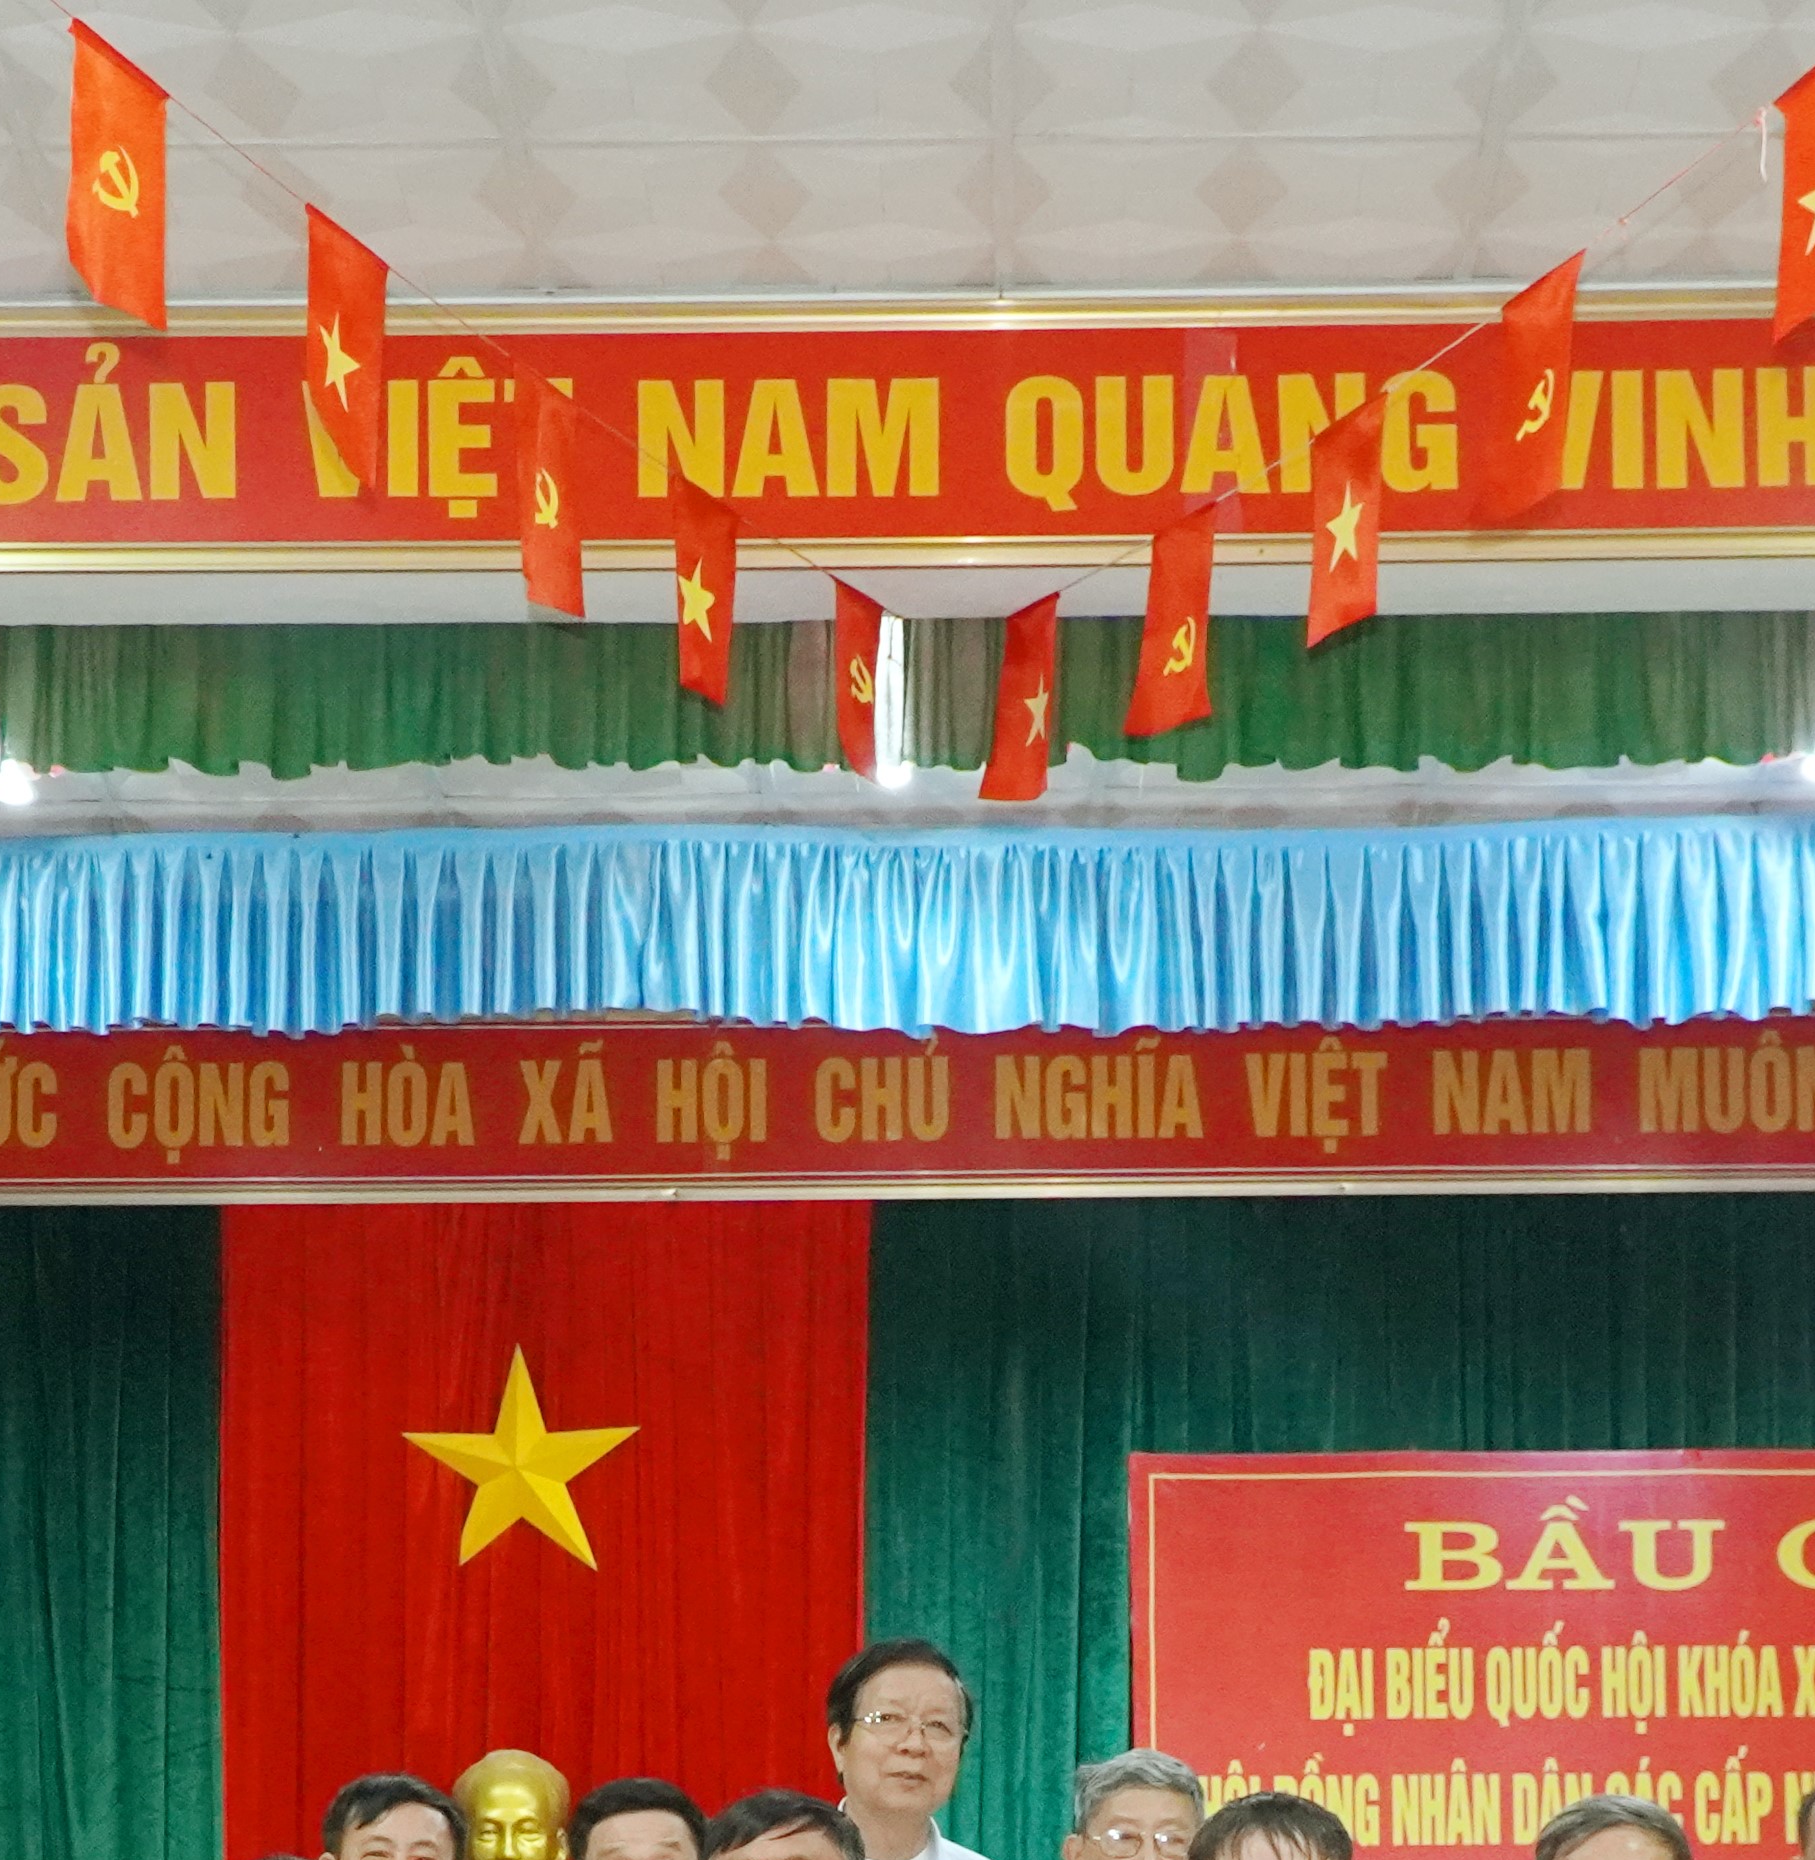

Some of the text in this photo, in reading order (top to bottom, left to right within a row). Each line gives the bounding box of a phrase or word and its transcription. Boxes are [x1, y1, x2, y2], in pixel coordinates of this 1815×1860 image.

[301, 355, 573, 519] IỆ
[637, 377, 940, 498] NAM
[1005, 370, 1459, 512] QUANG
[108, 1046, 289, 1164] CỘNG
[341, 1045, 474, 1147] HÒA
[519, 1040, 613, 1144] XÃ
[657, 1041, 767, 1161] HỘI
[815, 1038, 951, 1143] CHỦ
[994, 1036, 1203, 1141] NGHĨA
[1245, 1036, 1387, 1153] VIỆT
[1433, 1048, 1592, 1135] NAM
[1405, 1497, 1725, 1590] BẦU
[1308, 1648, 1374, 1736] ĐẠI
[1386, 1618, 1474, 1720] BIỂU
[1486, 1621, 1590, 1727] QUỐC
[1601, 1630, 1666, 1734] HỘI
[1678, 1630, 1783, 1718] KHÓA
[1273, 1752, 1381, 1847] ỒNG
[1392, 1757, 1504, 1845] NHÂN
[1695, 1746, 1773, 1844] CẤP
